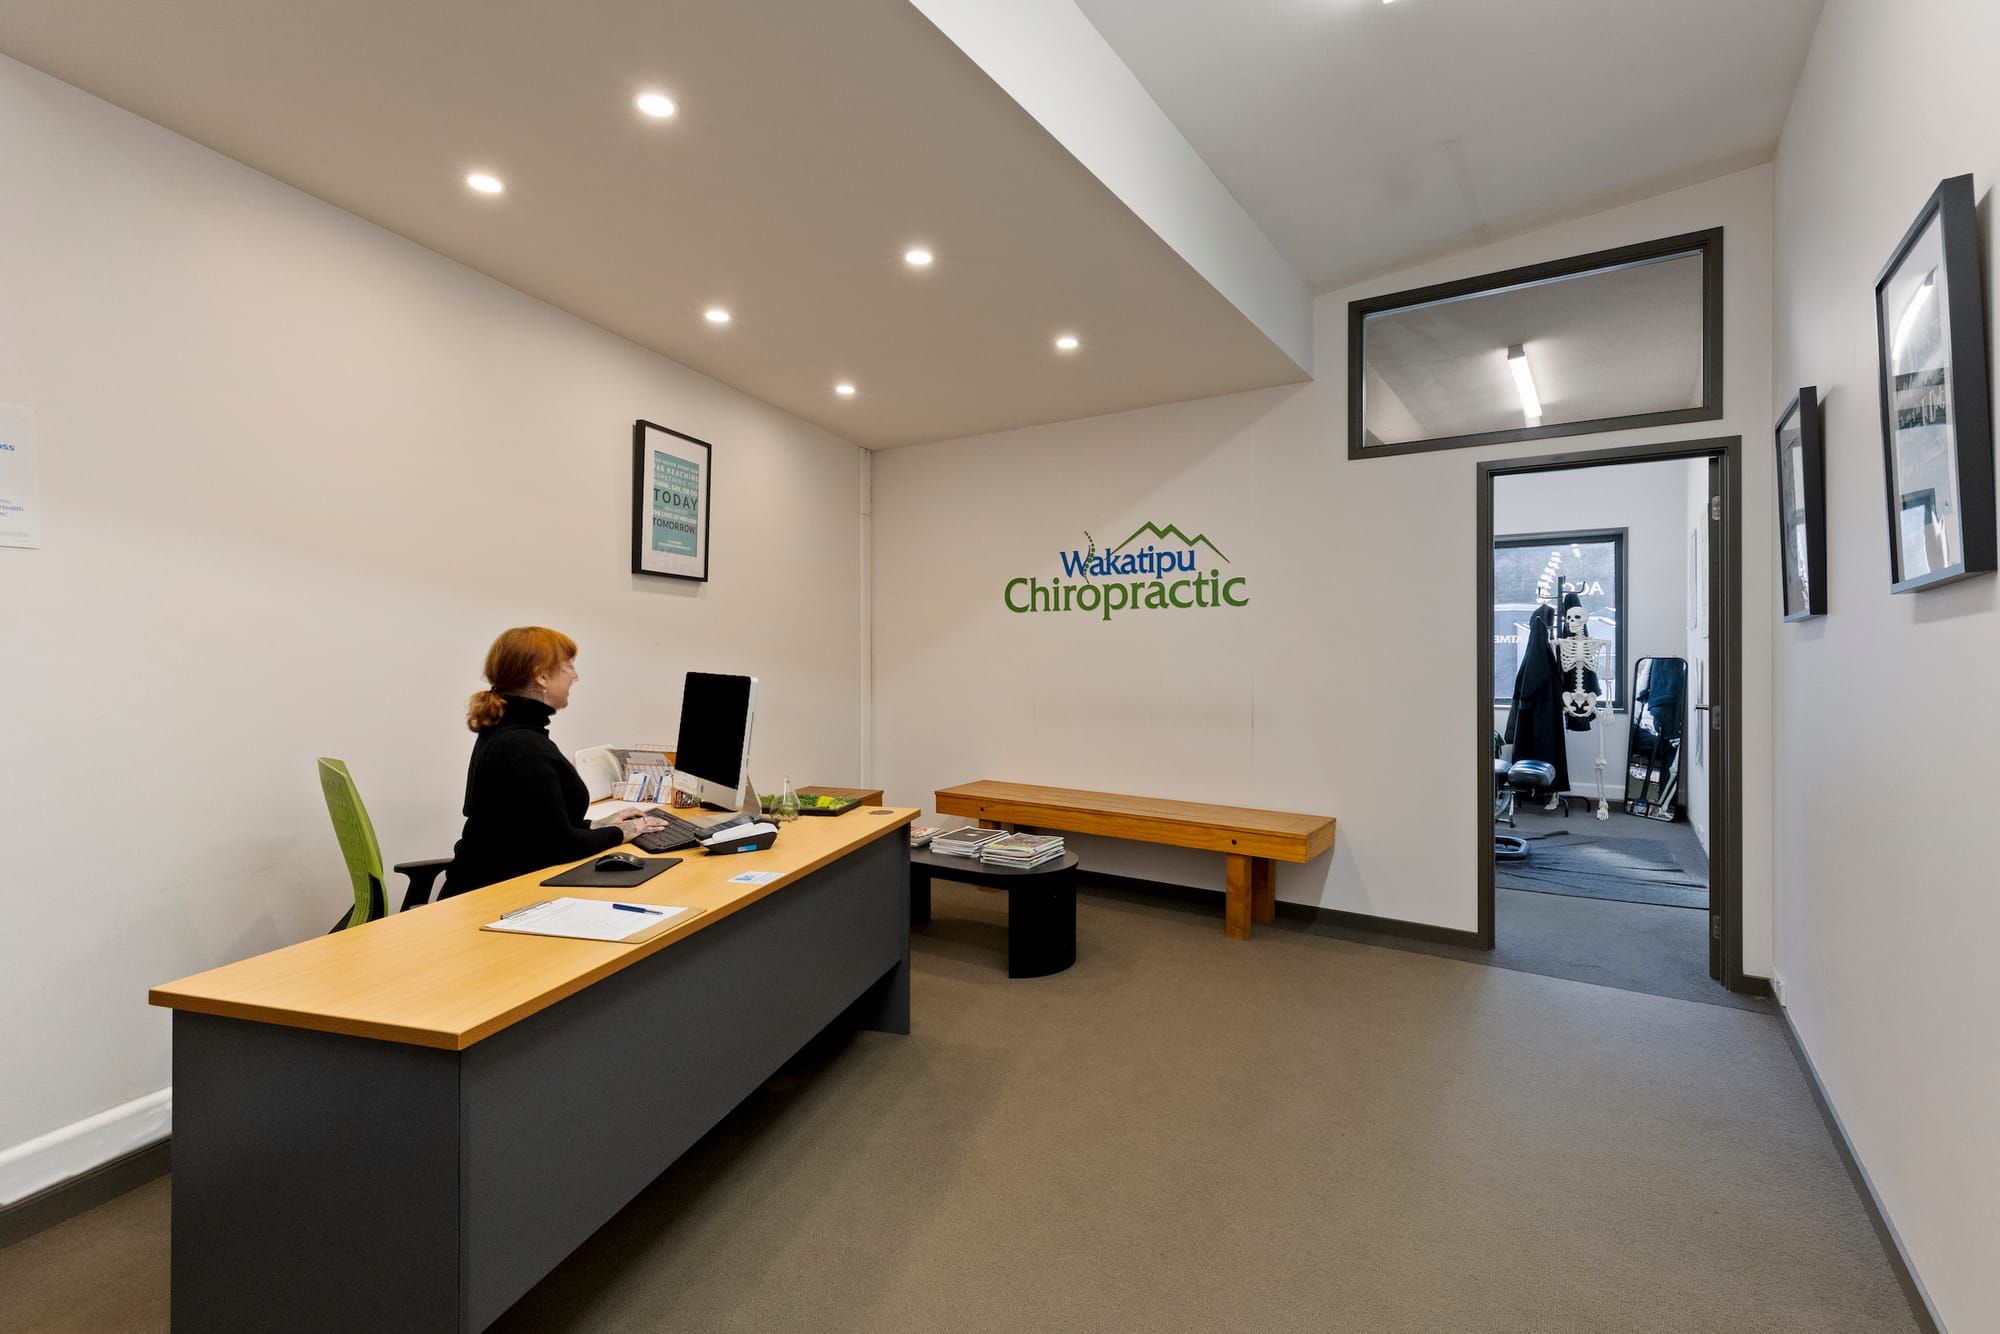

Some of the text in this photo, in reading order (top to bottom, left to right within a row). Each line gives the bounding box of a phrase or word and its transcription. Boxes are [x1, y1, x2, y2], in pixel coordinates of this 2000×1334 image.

[653, 488, 698, 511] TODAY
[652, 517, 697, 535] TOMORROW.
[1059, 545, 1196, 579] Wakatipu
[1004, 569, 1249, 621] Chiropractic
